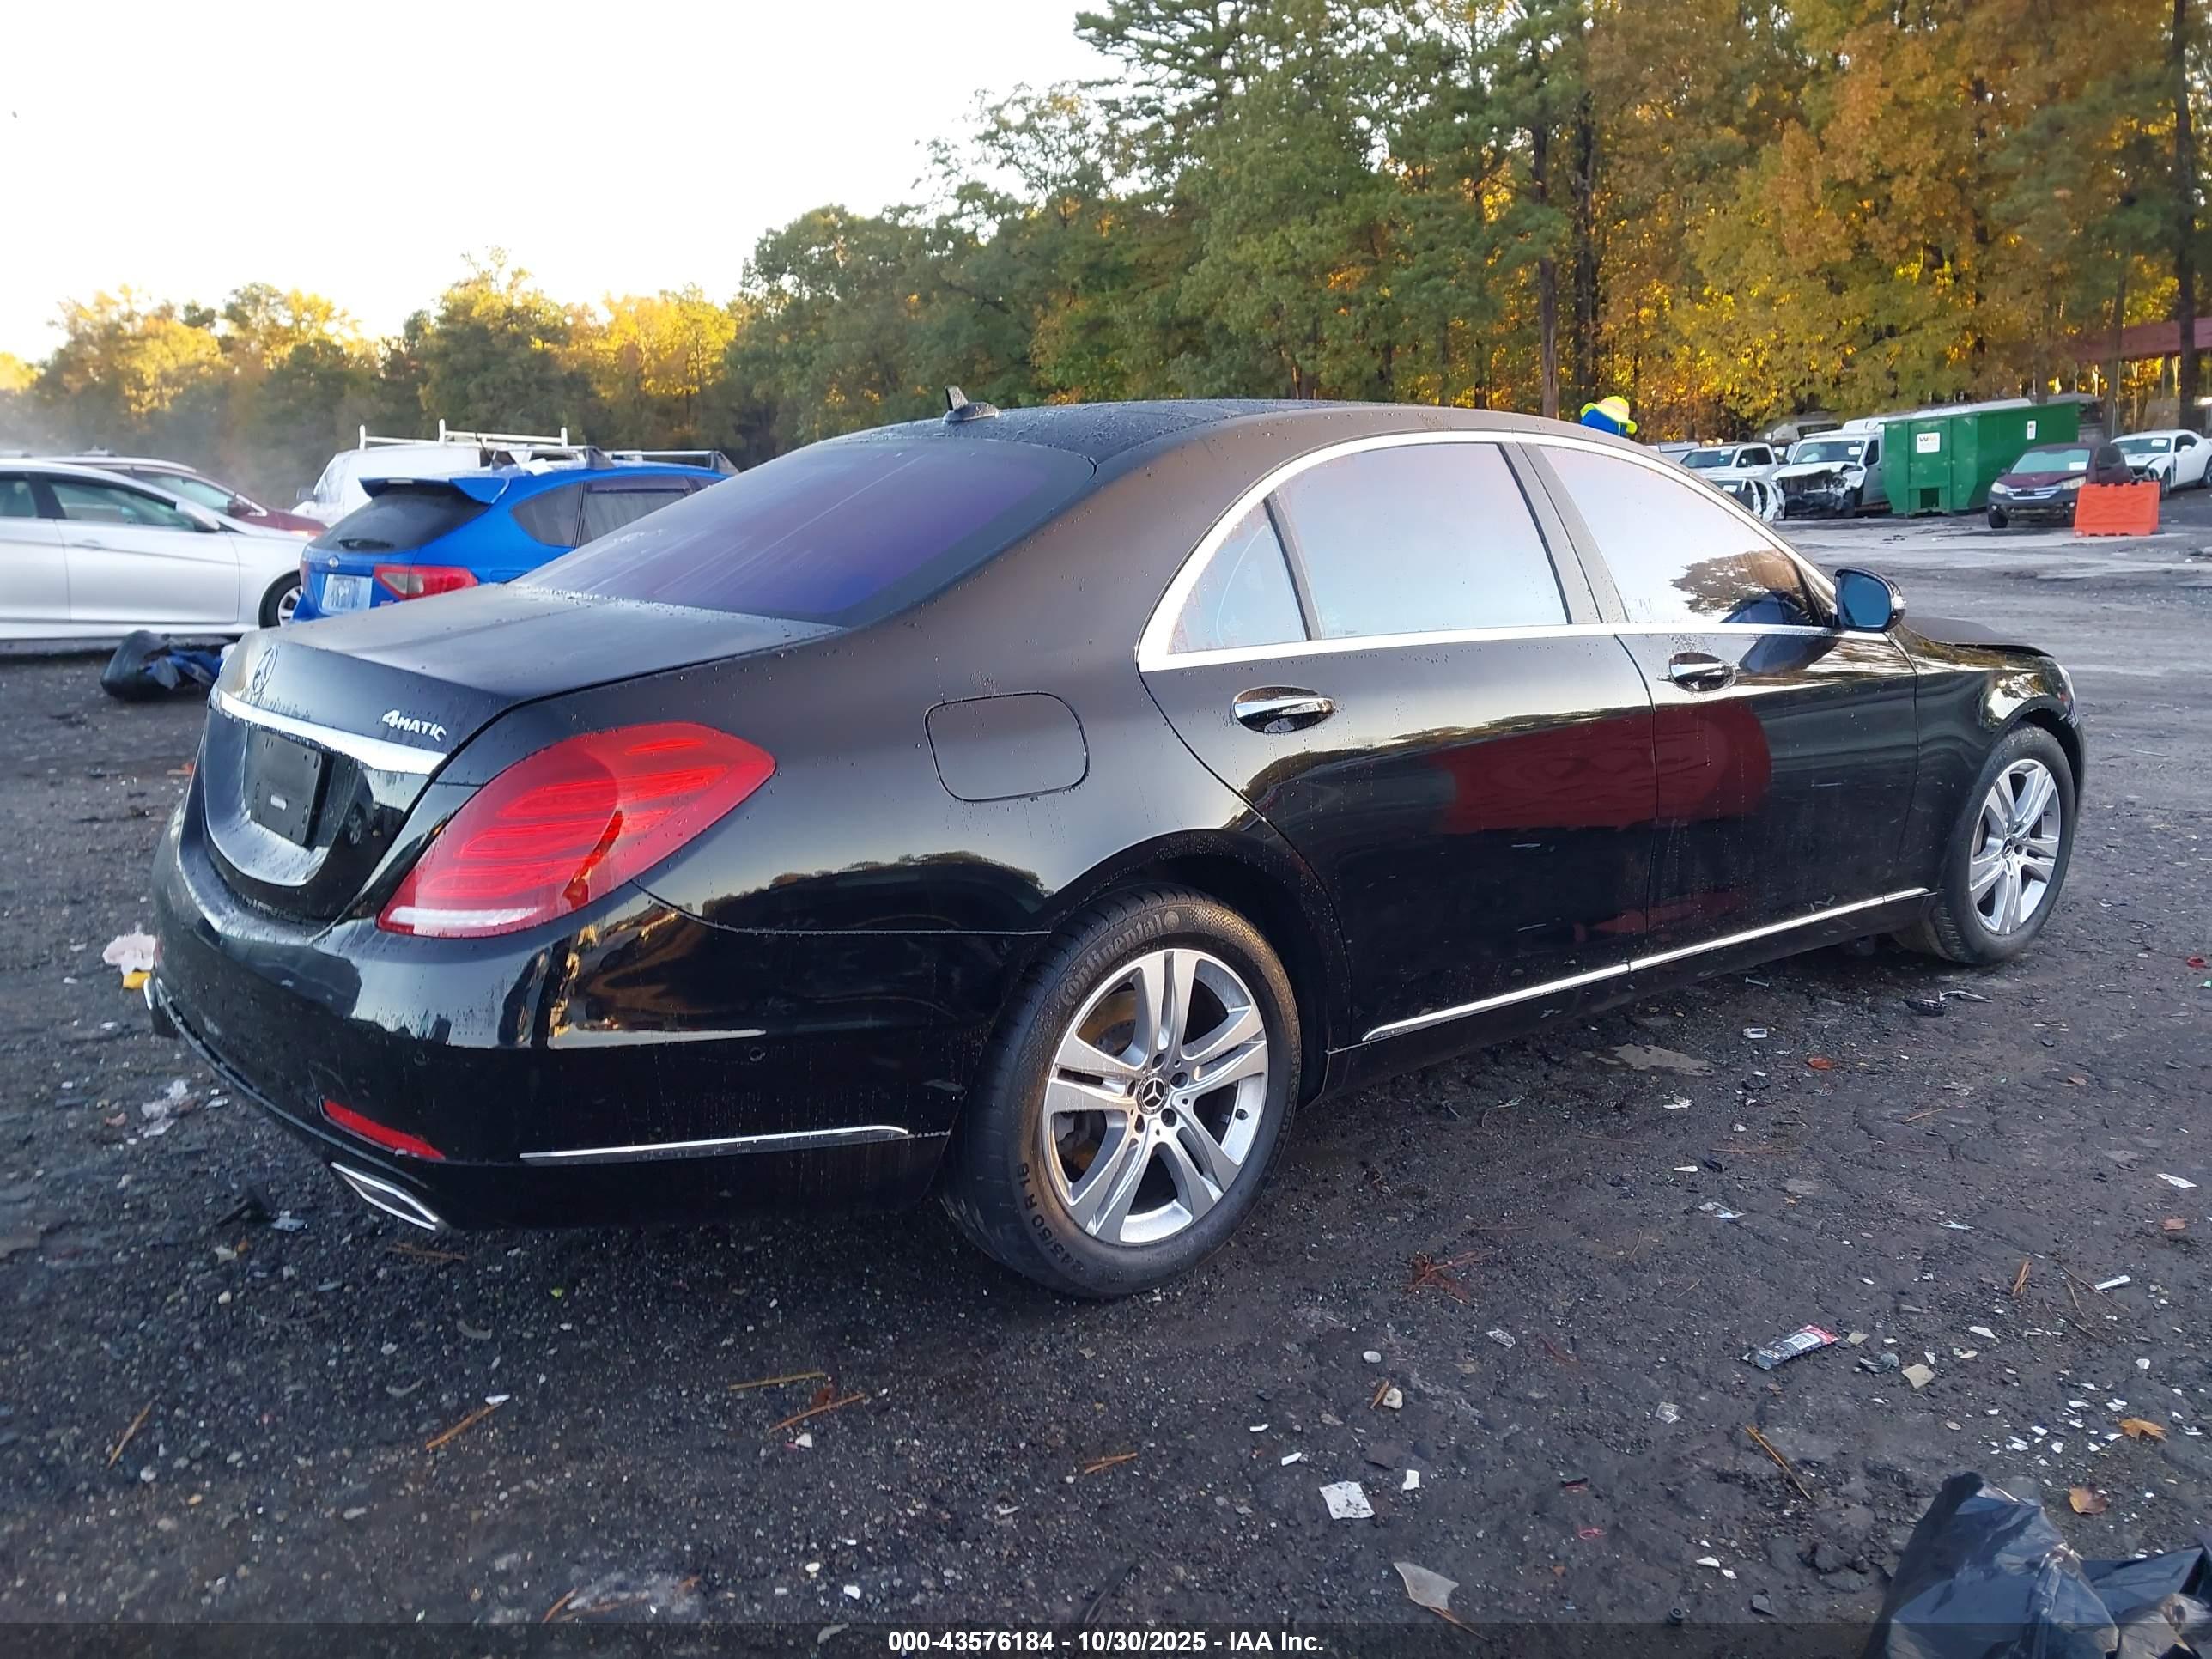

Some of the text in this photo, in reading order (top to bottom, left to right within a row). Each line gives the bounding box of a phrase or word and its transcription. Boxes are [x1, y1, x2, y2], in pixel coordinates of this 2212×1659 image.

[381, 709, 447, 742] 4MATIC
[1059, 914, 1163, 1006] Continental
[1023, 1194, 1038, 1210] R
